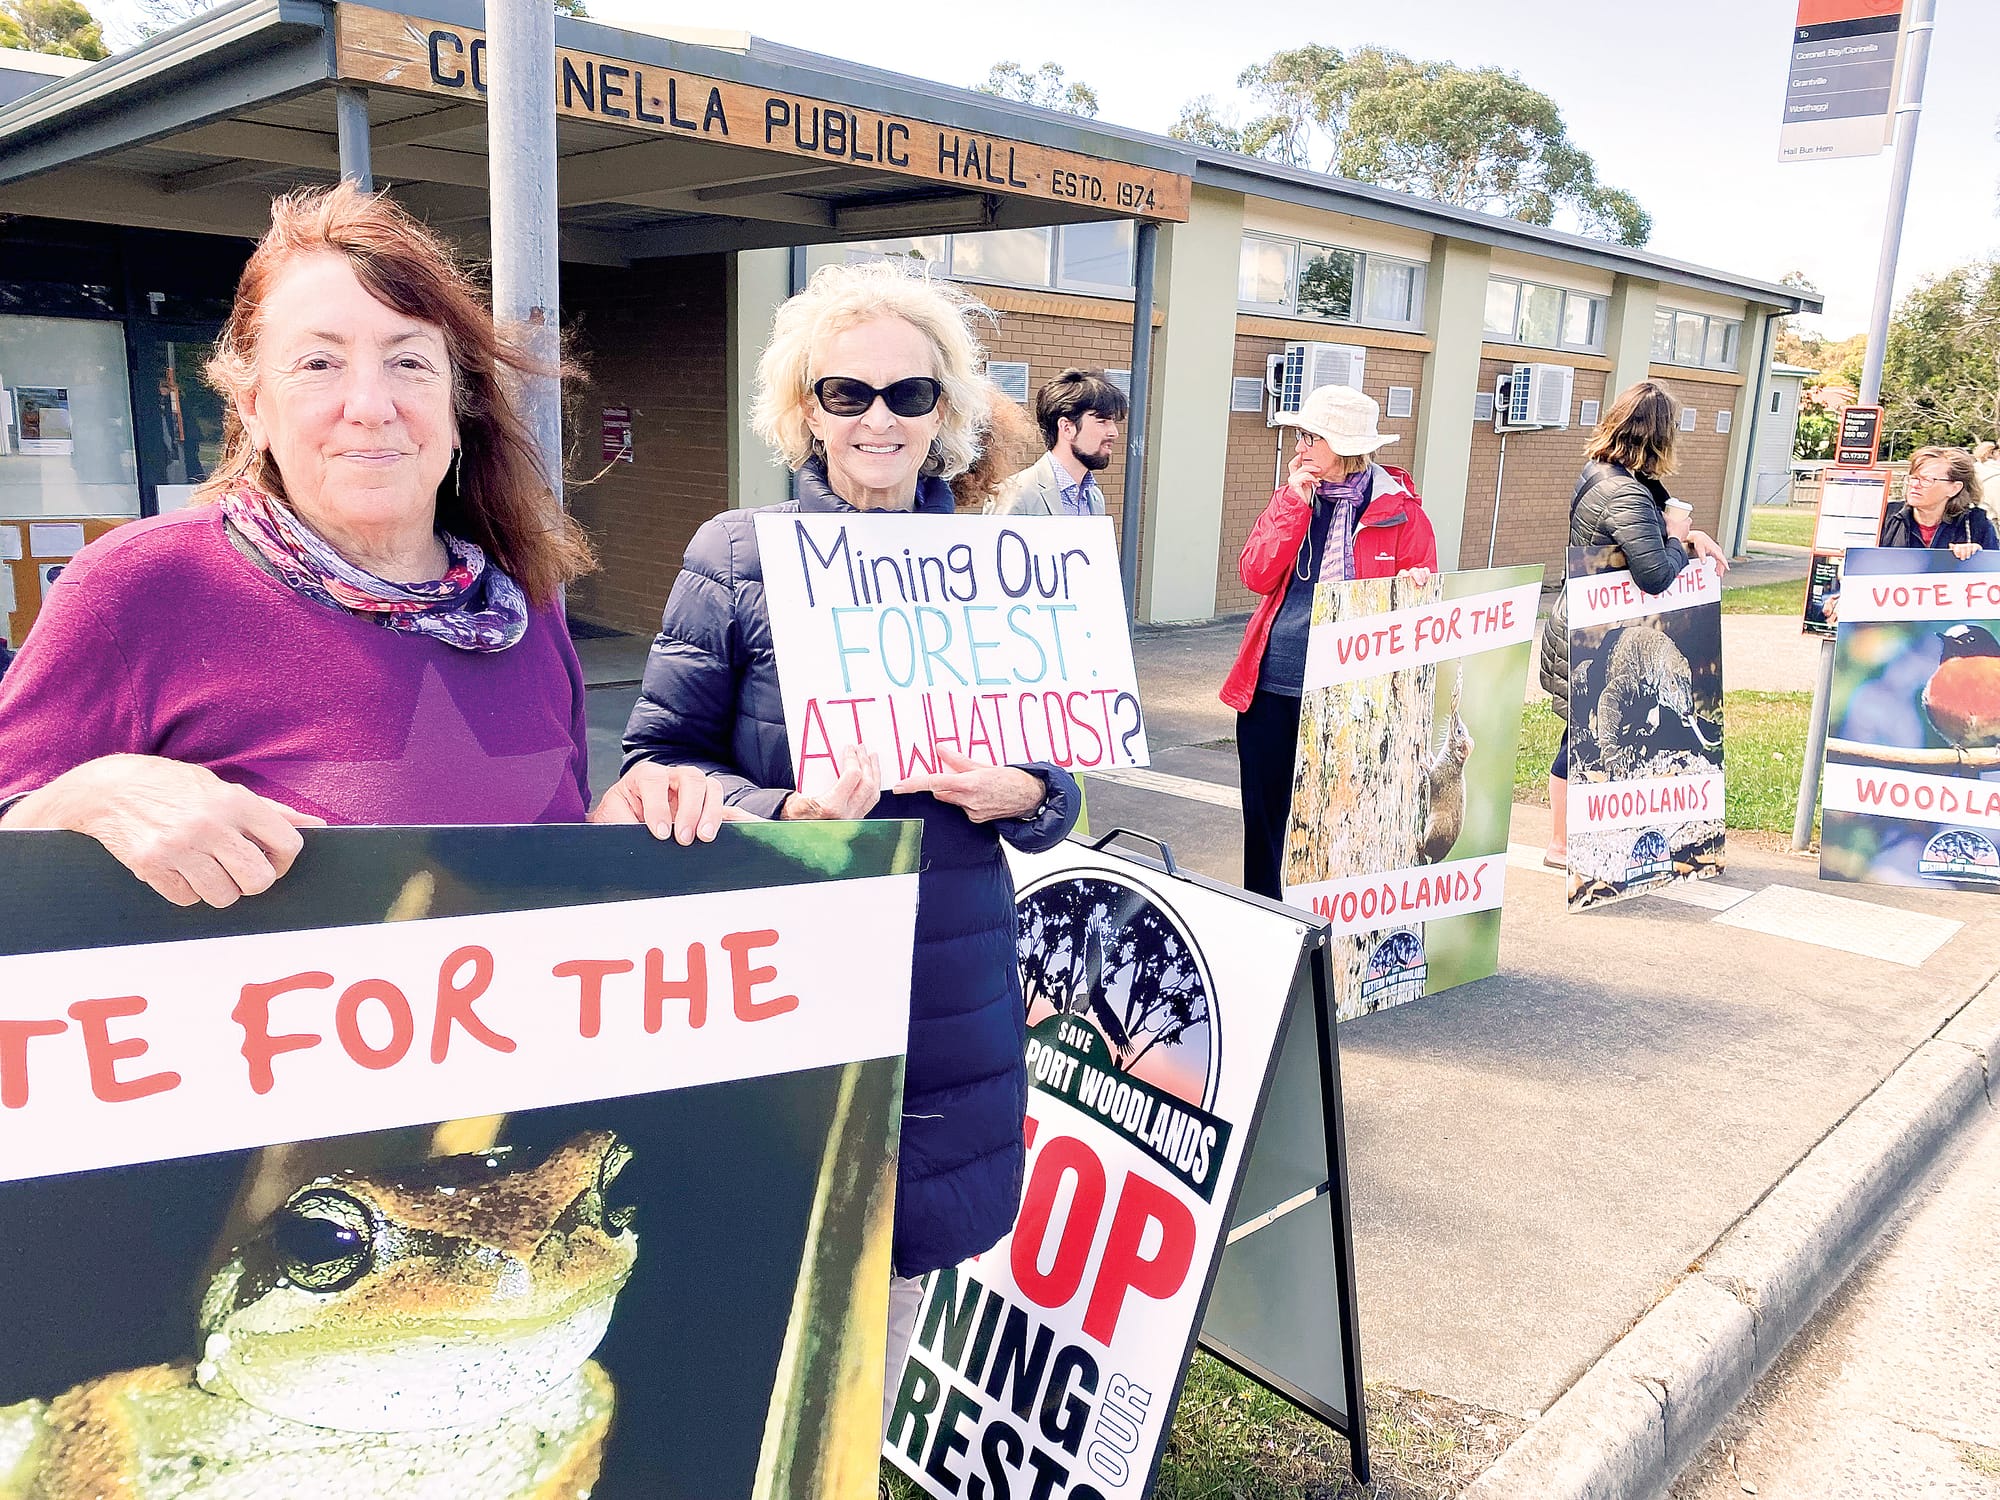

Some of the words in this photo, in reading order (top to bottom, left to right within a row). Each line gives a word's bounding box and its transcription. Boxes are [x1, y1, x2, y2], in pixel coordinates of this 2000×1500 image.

[1799, 30, 1809, 39] To
[765, 98, 909, 167] PUBLIC
[938, 131, 1027, 189] HALL
[1051, 169, 1107, 203] ESTD.
[1800, 146, 1814, 154] Bus
[794, 519, 978, 608] Mining
[996, 528, 1091, 600] Our
[1587, 581, 1634, 611] VOTE
[1677, 568, 1706, 594] THE
[1872, 584, 1953, 608] VOTE
[1964, 582, 2000, 608] FO
[831, 603, 1098, 693] FOREST:
[1337, 623, 1405, 665] VOTE
[1414, 607, 1462, 652] FOR
[1470, 600, 1515, 635] THE
[797, 697, 876, 794] AT
[887, 691, 1009, 780] WHAT
[1018, 689, 1141, 765] COST?
[1588, 780, 1711, 822] WOODLANDS
[1312, 862, 1488, 924] WOODLANDS
[230, 944, 518, 1096] FOR
[552, 928, 800, 1040] THE
[1057, 1021, 1095, 1054] SAVE
[1025, 1038, 1082, 1094] PORT
[1078, 1063, 1218, 1185] WOODLANDS
[1010, 1115, 1197, 1348] OP
[918, 1267, 1100, 1458] NING
[885, 1355, 1108, 1500] REST
[1087, 1373, 1153, 1488] OUR
